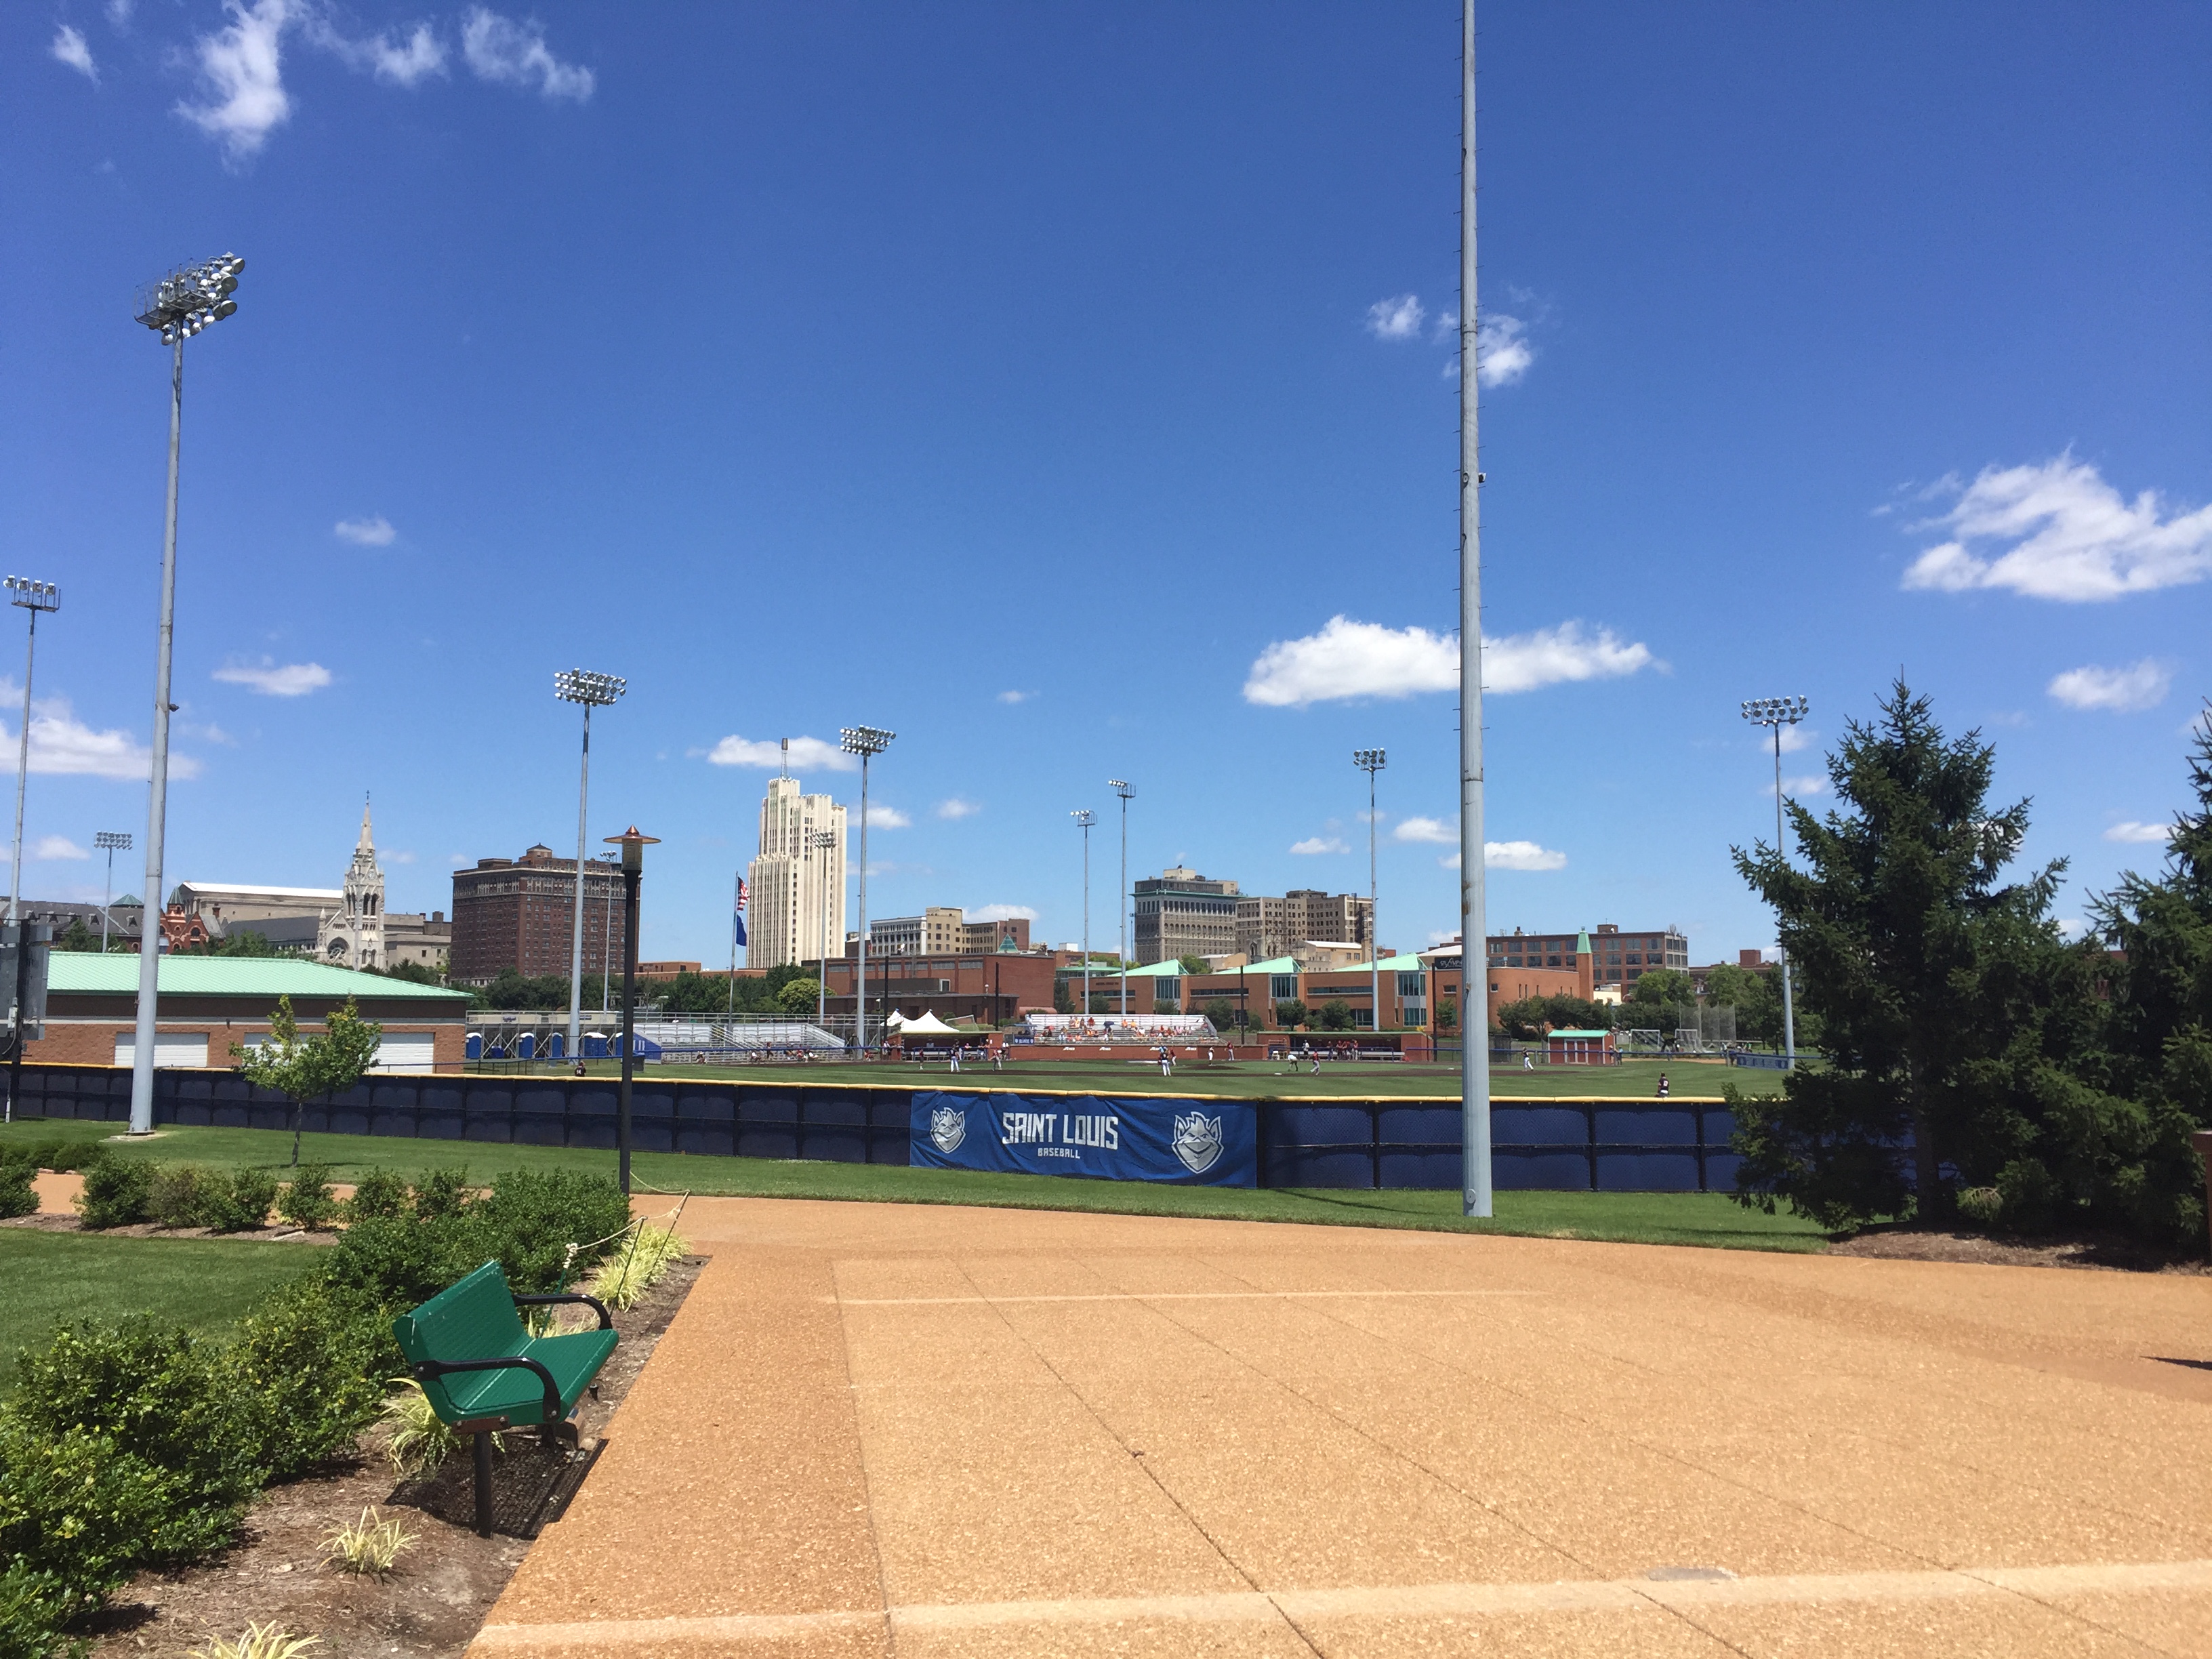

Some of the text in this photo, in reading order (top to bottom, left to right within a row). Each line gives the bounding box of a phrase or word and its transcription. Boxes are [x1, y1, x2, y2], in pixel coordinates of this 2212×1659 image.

[1002, 1112, 1118, 1150] SAINT LOUIS
[1038, 1147, 1080, 1159] BASEBALL
